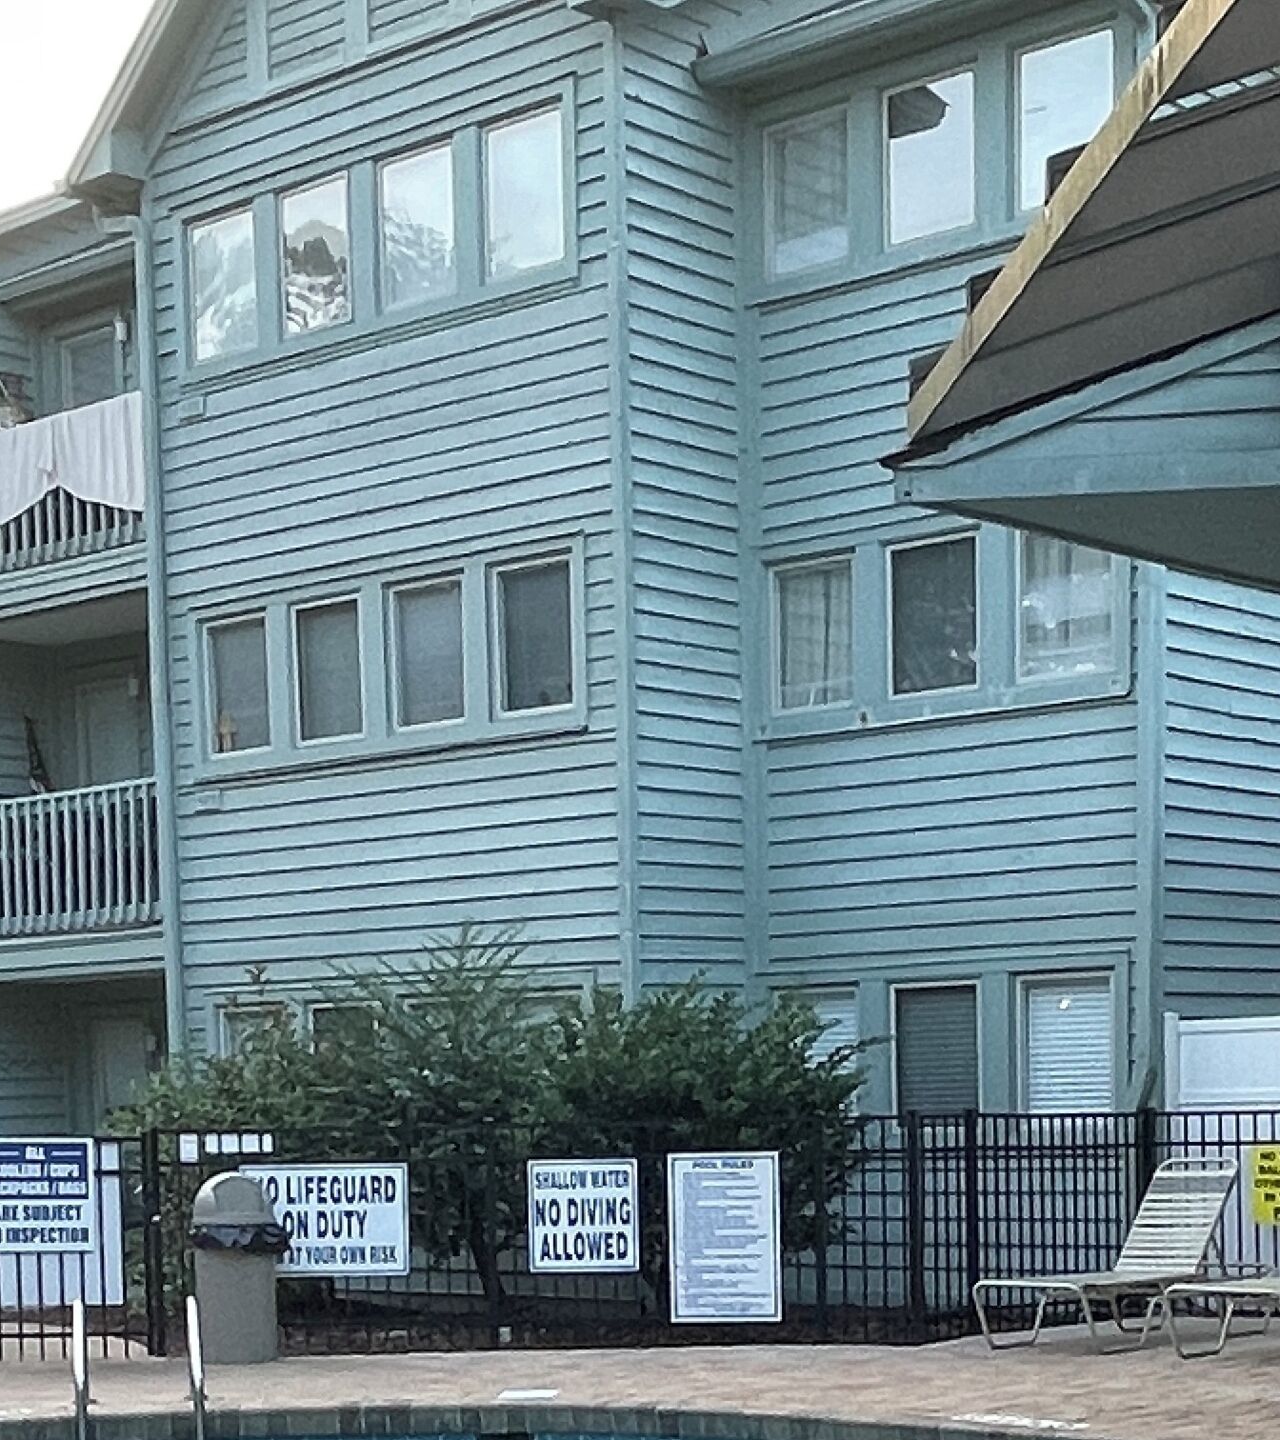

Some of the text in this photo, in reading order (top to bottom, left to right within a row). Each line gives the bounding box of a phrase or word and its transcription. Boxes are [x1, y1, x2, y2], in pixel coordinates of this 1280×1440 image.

[261, 1175, 396, 1205] O LIFEGUARD
[536, 1169, 629, 1190] SHALLOW WATER
[23, 1204, 82, 1221] SUBJECT
[283, 1210, 368, 1239] ON DUTY
[536, 1197, 631, 1227] NO DIVING
[6, 1227, 89, 1243] INSPECTION
[540, 1231, 628, 1261] ALLOWED
[306, 1246, 337, 1264] YOUR
[340, 1246, 366, 1264] OWN
[370, 1245, 397, 1264] RISK
